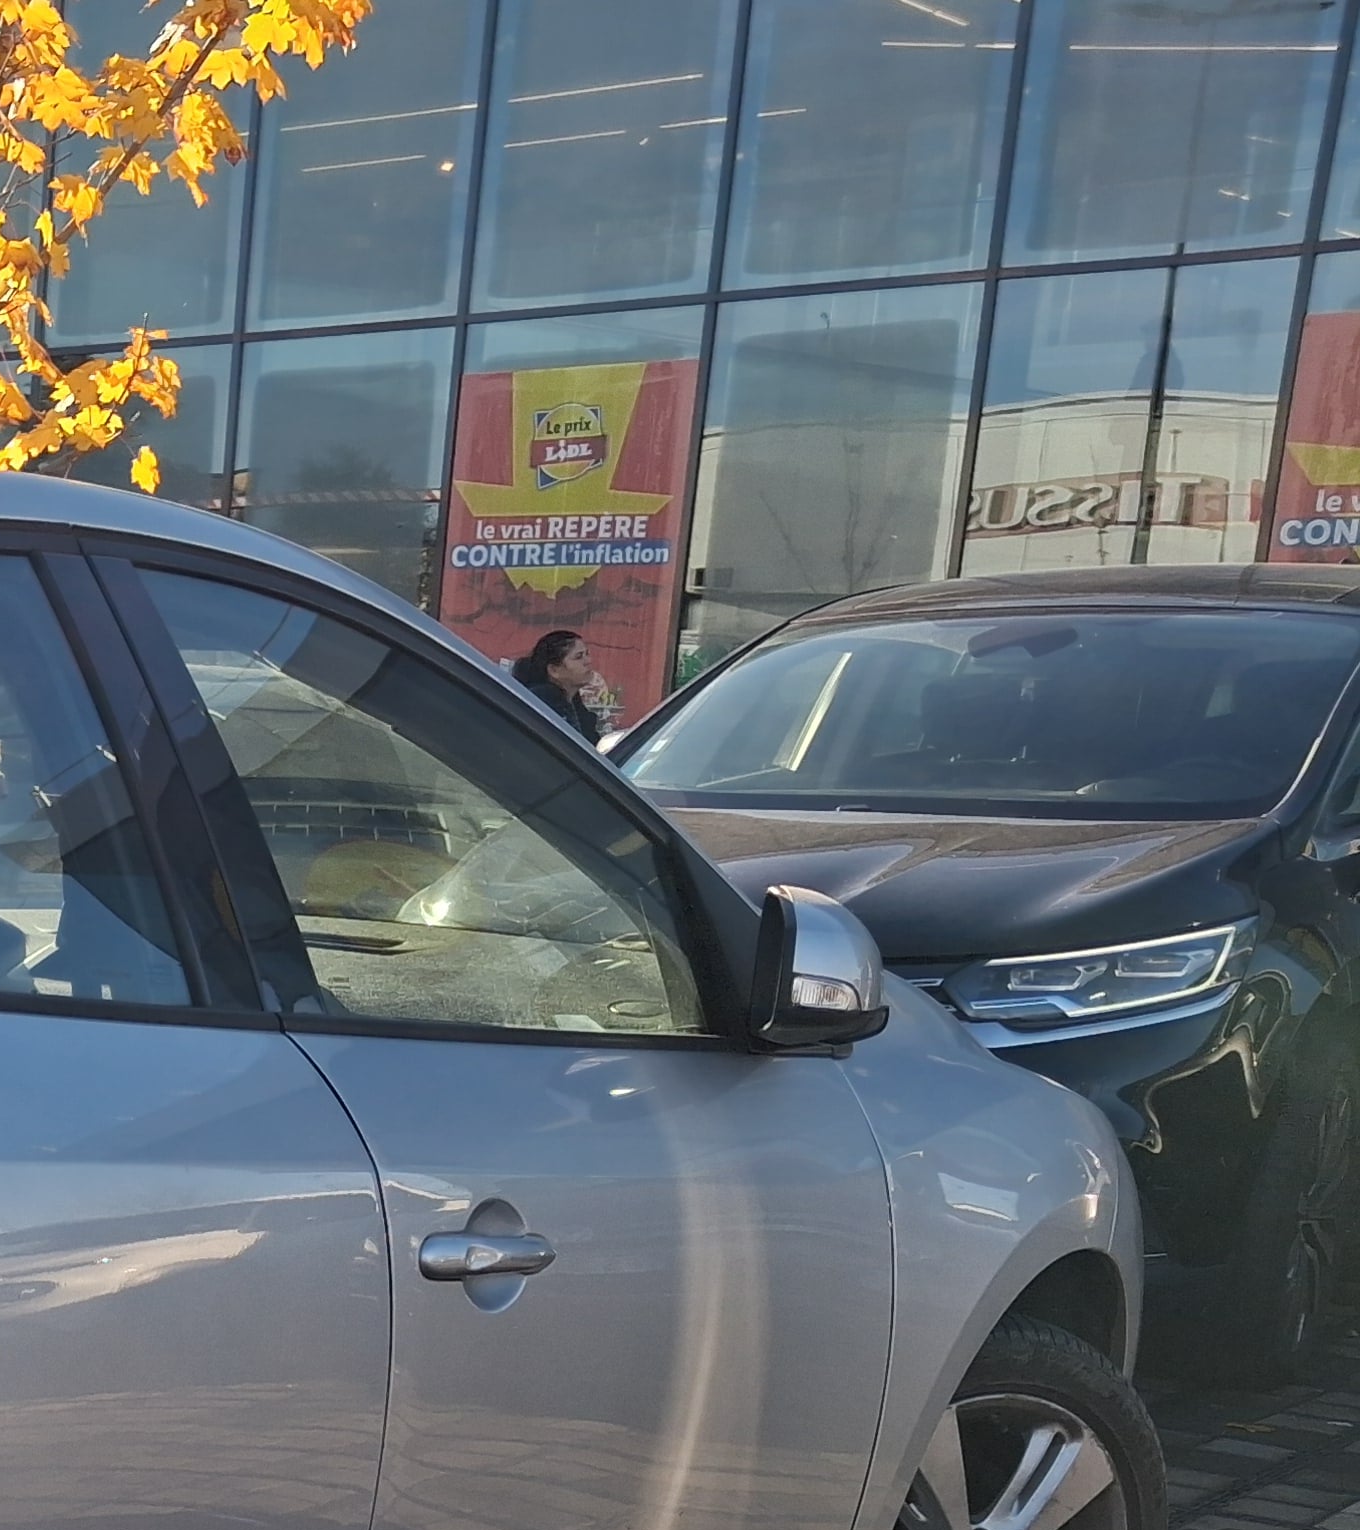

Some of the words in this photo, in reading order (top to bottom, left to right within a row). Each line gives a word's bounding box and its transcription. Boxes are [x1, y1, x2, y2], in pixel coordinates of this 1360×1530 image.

[546, 421, 561, 435] Le
[564, 417, 592, 436] prix
[1315, 488, 1343, 513] le
[476, 519, 496, 539] le
[500, 519, 542, 539] vrai
[547, 512, 649, 538] REPÈRE
[451, 543, 558, 568] CONTRE
[560, 542, 670, 565] l'inflation
